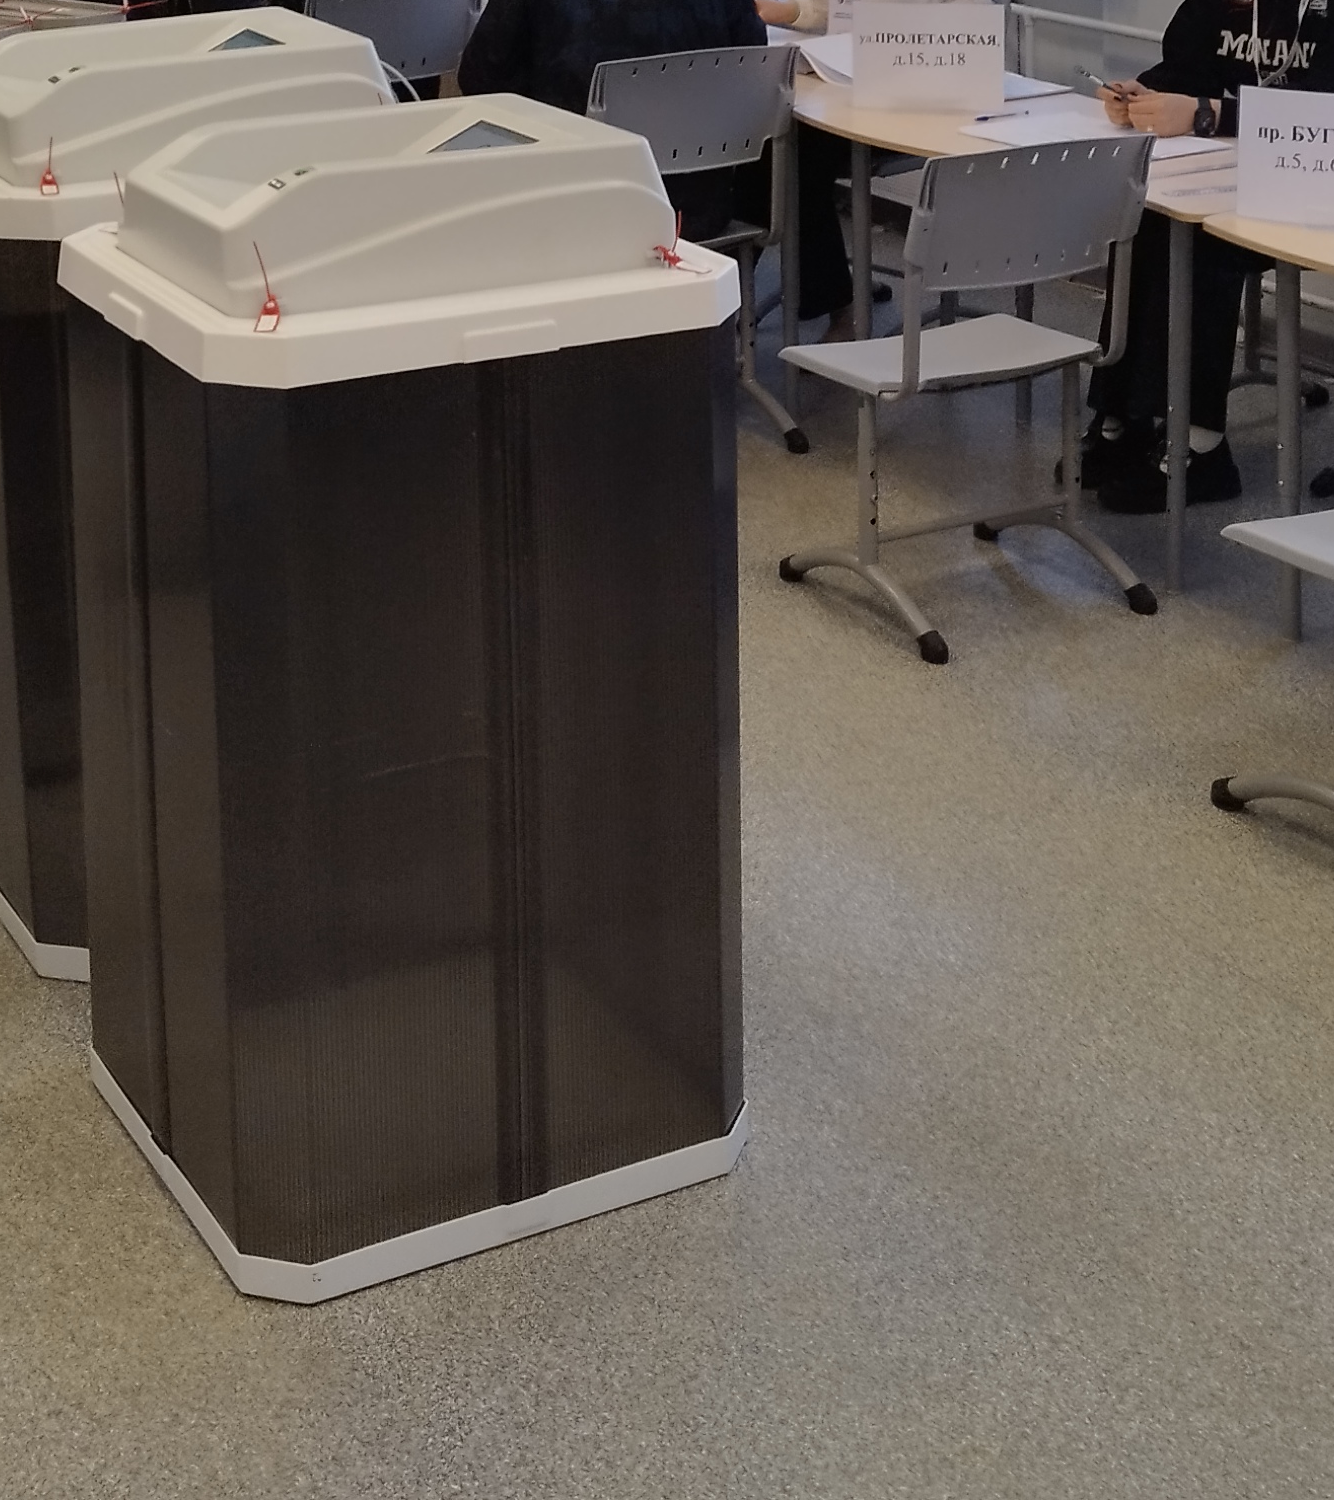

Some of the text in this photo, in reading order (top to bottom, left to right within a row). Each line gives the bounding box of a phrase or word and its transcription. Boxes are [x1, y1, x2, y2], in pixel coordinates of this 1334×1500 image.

[892, 52, 966, 66] д.15, д.18
[1258, 126, 1285, 143] пр.
[1275, 153, 1307, 172] д.5,
